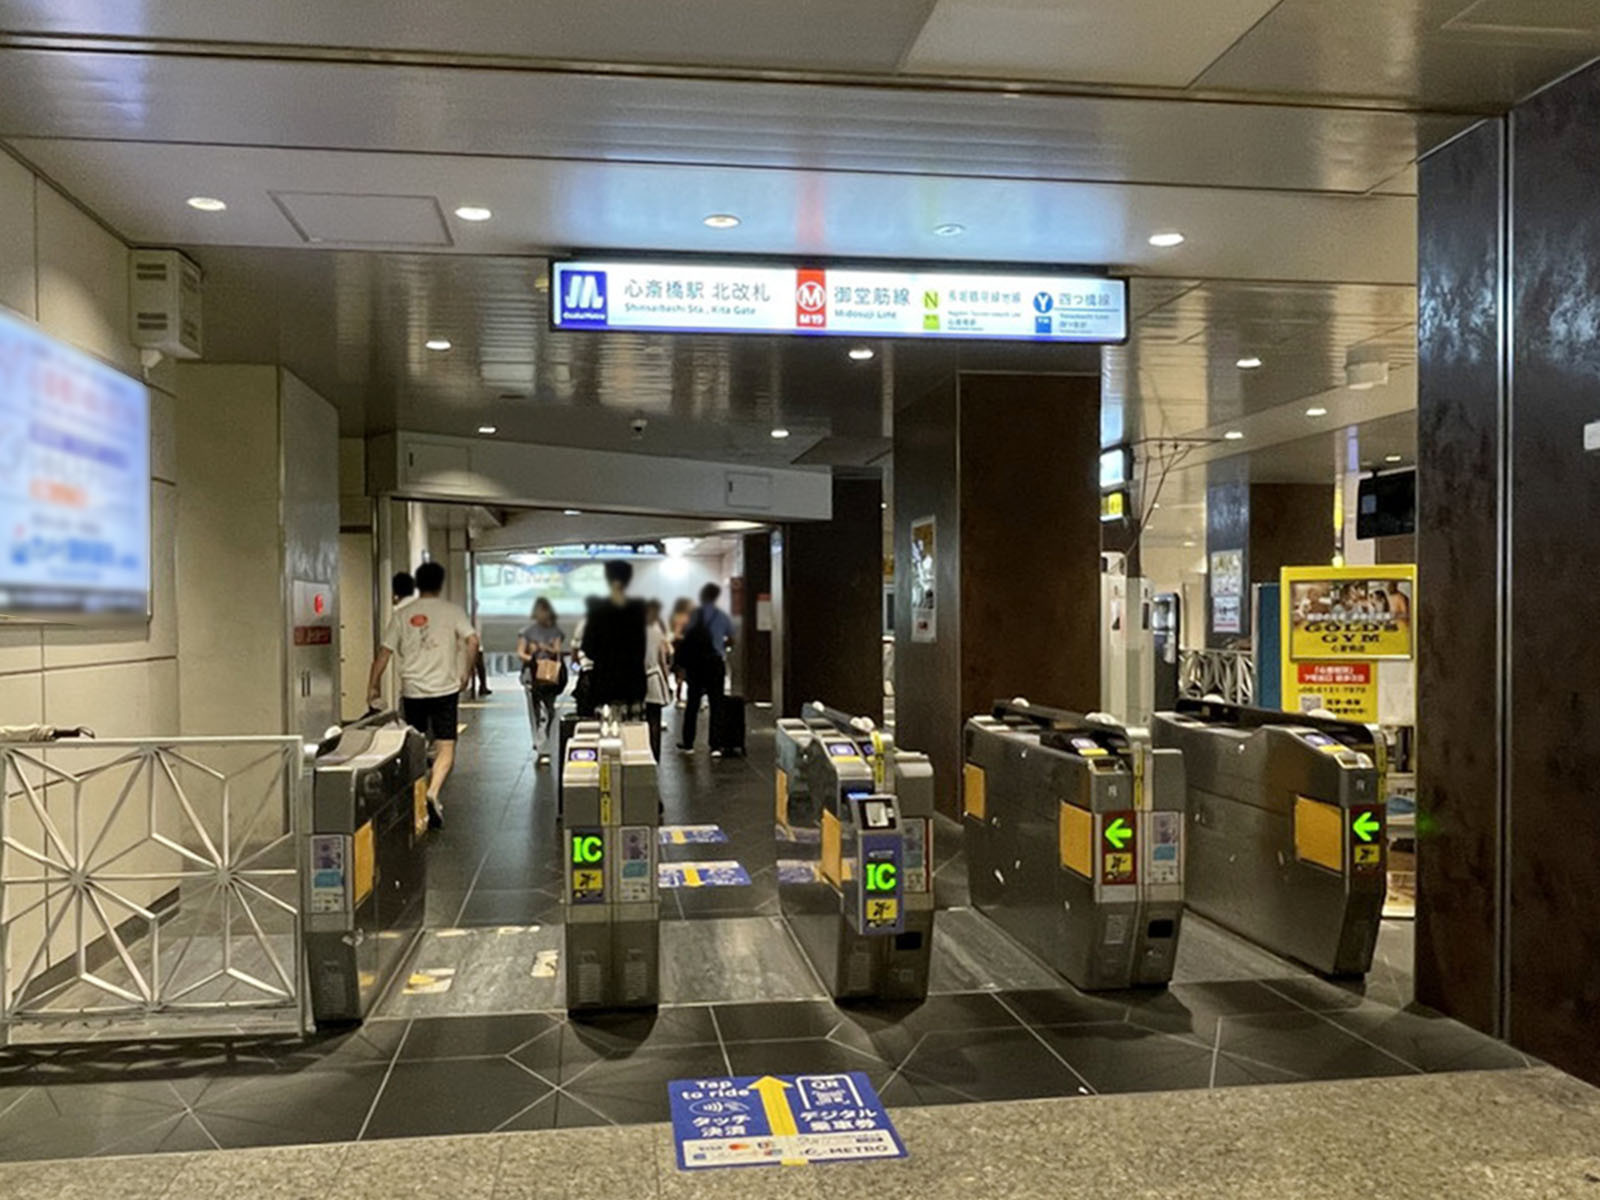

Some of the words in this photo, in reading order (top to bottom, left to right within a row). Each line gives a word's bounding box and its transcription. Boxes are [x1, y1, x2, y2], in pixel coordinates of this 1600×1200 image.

[624, 279, 704, 300] 心斎橋駅
[712, 282, 771, 302] 北改札
[834, 286, 911, 306] 御堂筋線
[923, 291, 939, 310] N
[734, 305, 756, 315] Gate
[1321, 634, 1380, 643] GYM
[573, 836, 602, 862] IC
[866, 863, 897, 889] IC
[695, 1080, 733, 1090] Tap
[811, 1080, 840, 1090] QR
[682, 1089, 705, 1099] to
[709, 1087, 750, 1098] ride
[692, 1114, 750, 1127] タッチ
[800, 1108, 878, 1122] デジタル
[829, 1144, 888, 1155] METRO
